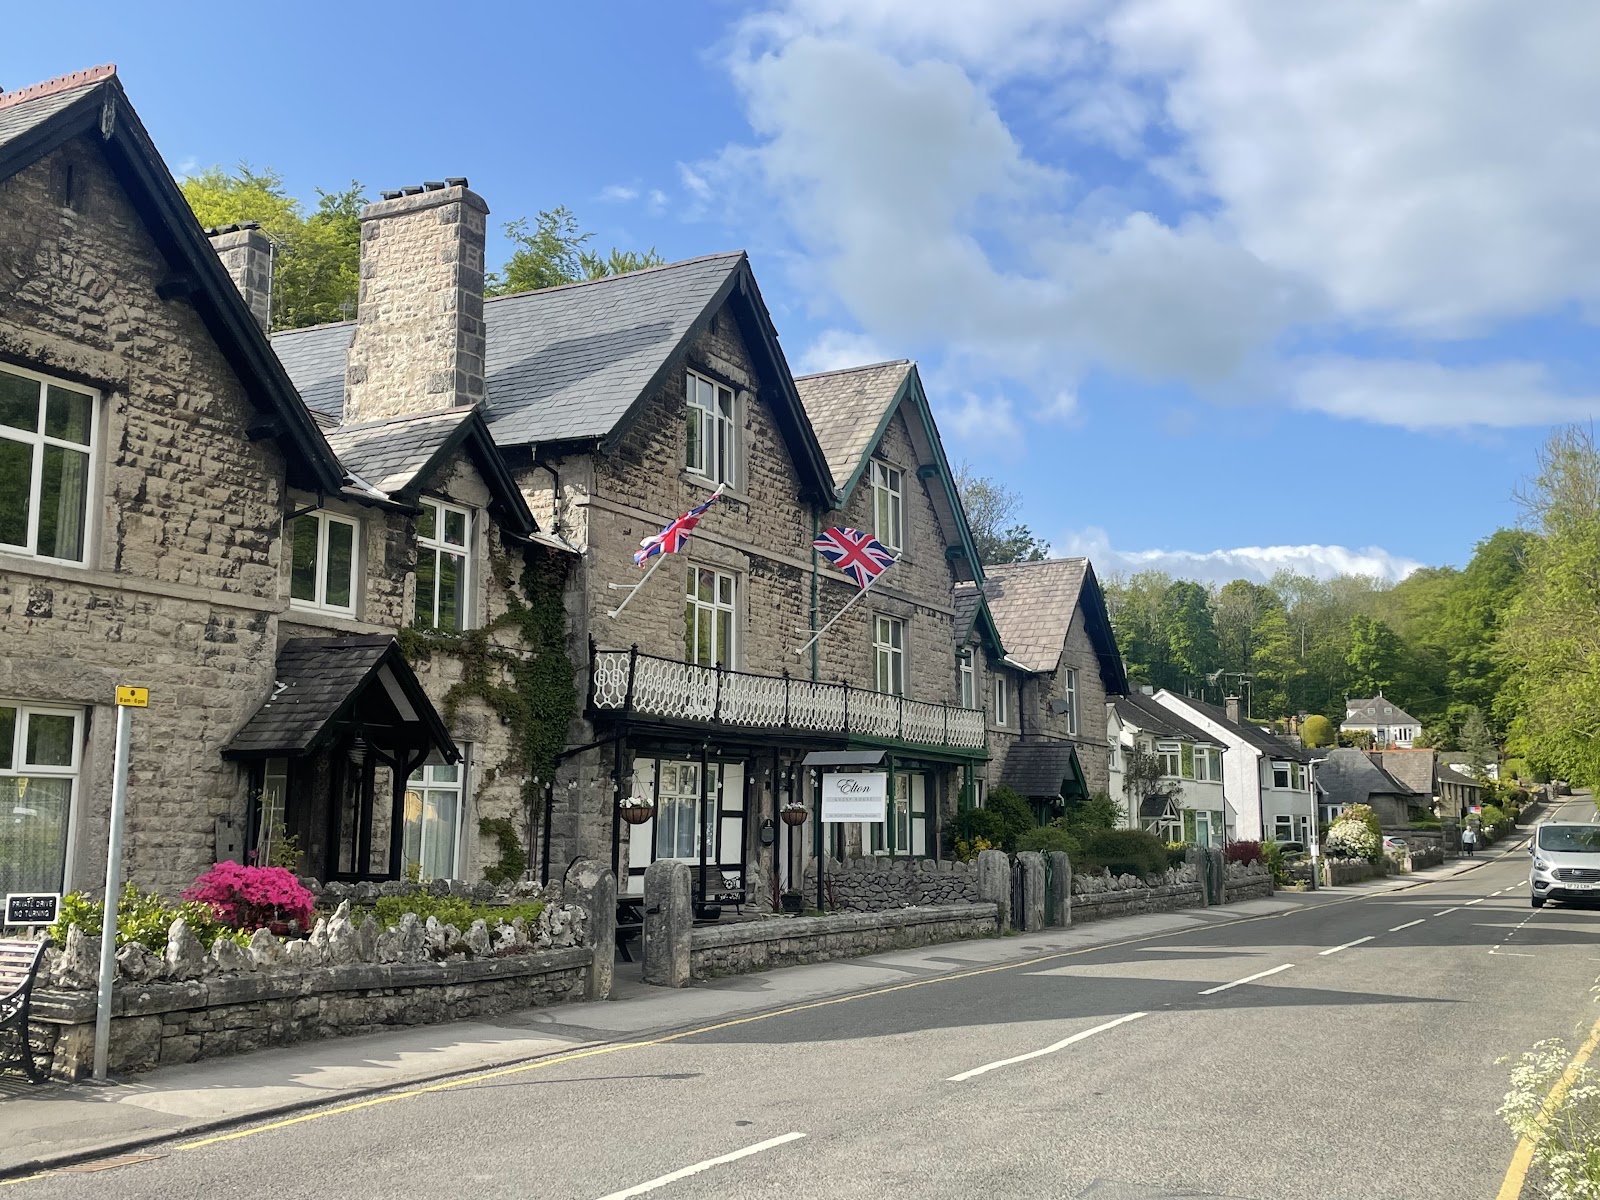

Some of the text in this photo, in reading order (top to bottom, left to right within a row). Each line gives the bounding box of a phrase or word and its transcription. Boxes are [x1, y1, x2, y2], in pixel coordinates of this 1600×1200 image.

[836, 779, 871, 795] Elton
[12, 900, 54, 908] PRIVATE DRIVE
